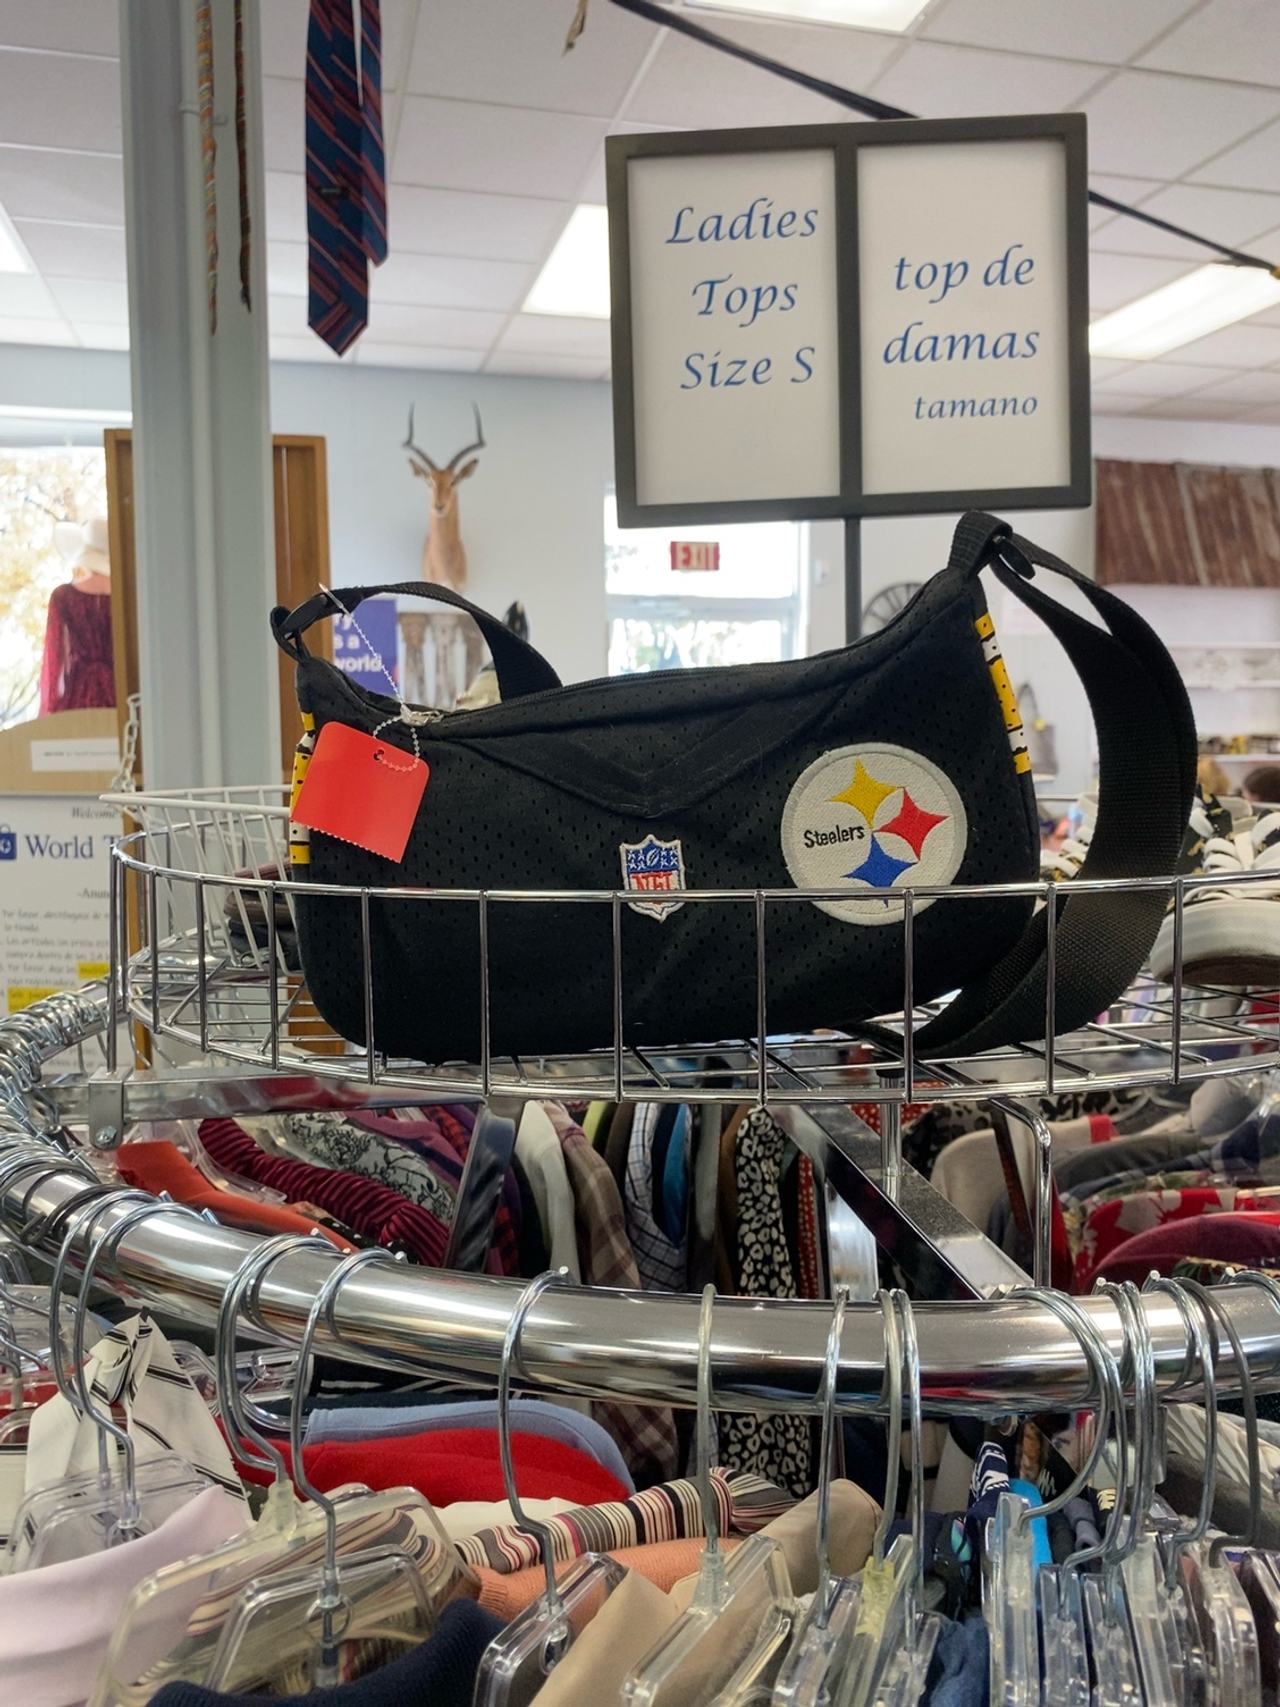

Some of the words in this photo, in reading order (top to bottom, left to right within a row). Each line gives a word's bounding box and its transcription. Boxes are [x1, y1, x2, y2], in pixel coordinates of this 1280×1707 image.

[665, 197, 819, 245] Ladies
[894, 256, 968, 303] top
[983, 244, 1035, 287] de
[692, 273, 799, 328] Tops
[882, 321, 1040, 364] damas
[680, 350, 773, 390] Size
[791, 346, 816, 385] S
[914, 394, 1039, 420] tamano
[674, 543, 718, 569] EXIT
[25, 835, 94, 859] World
[803, 825, 866, 848] Steelers
